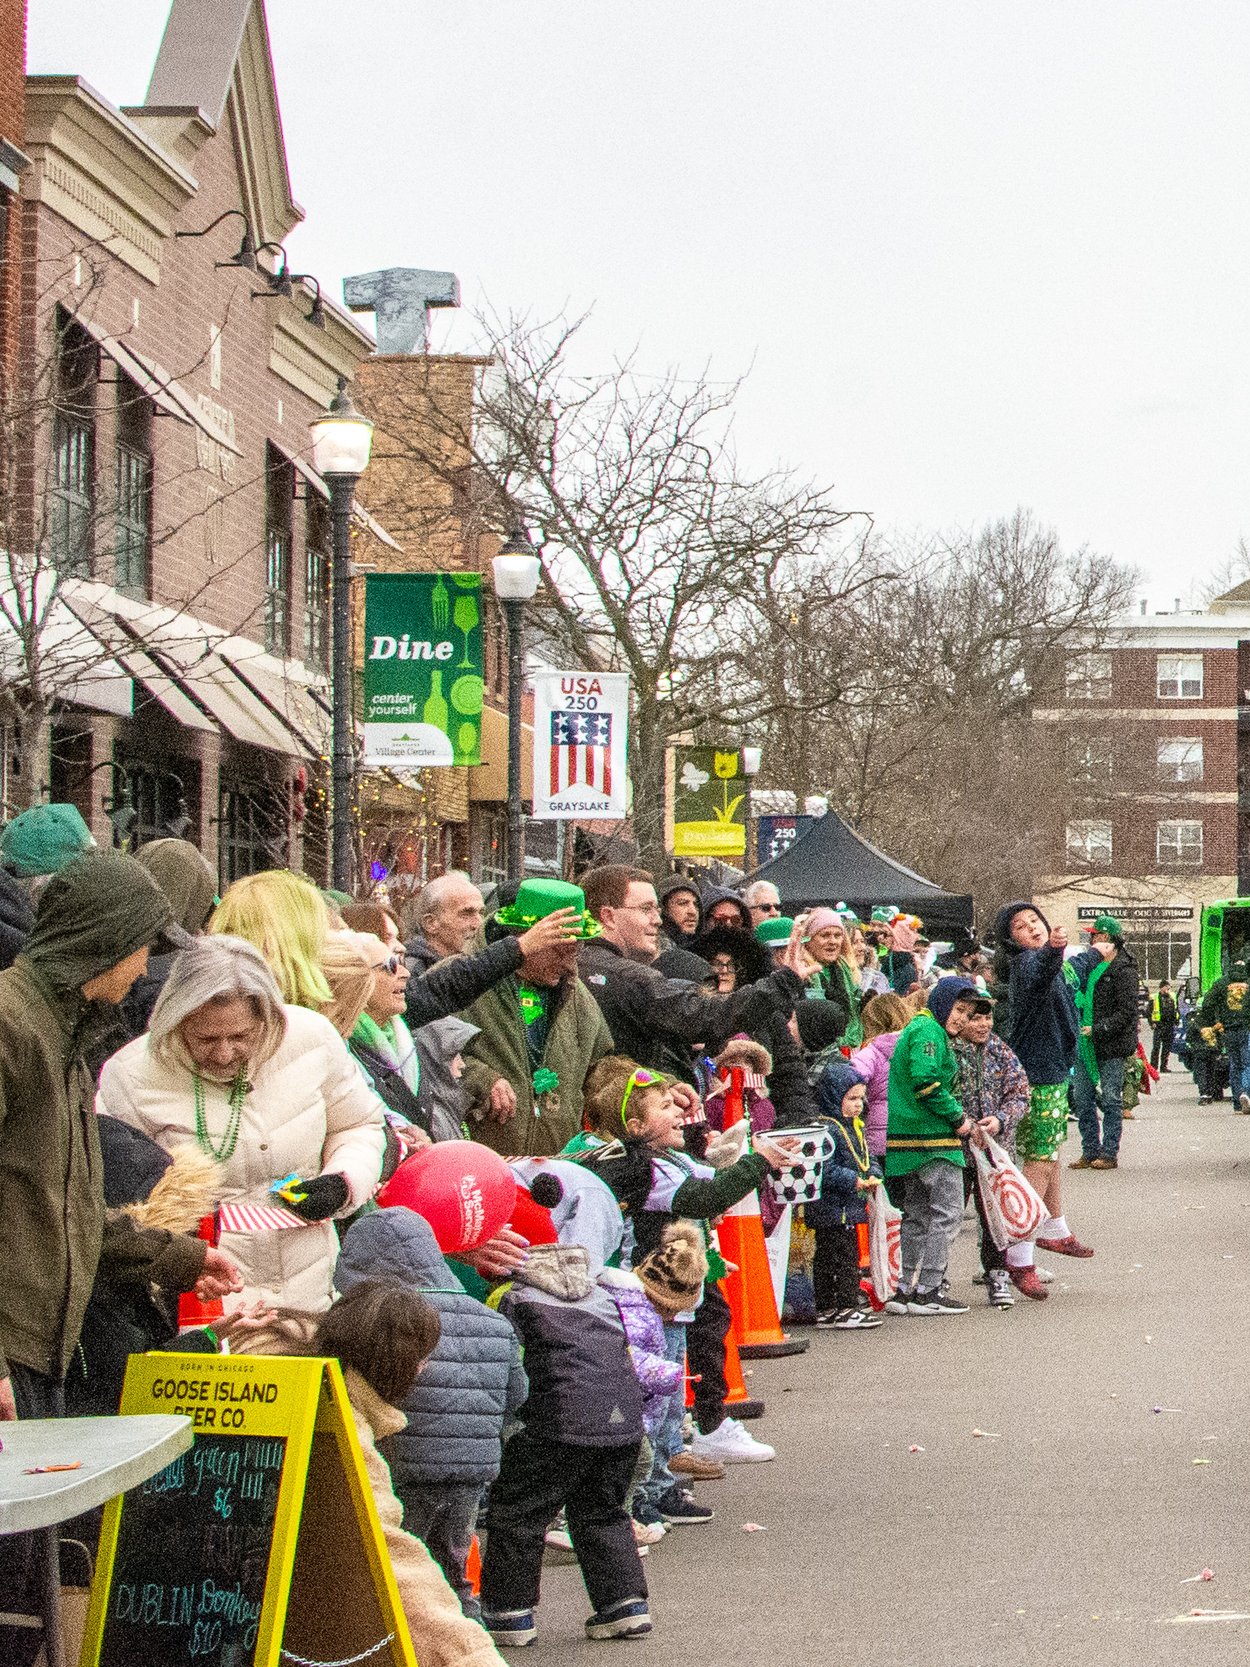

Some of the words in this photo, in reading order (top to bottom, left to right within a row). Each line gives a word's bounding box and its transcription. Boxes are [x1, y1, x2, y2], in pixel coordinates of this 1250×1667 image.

[369, 634, 454, 660] Dine
[561, 678, 603, 695] USA
[372, 692, 414, 704] center
[565, 696, 598, 711] 250
[368, 702, 417, 718] yourself
[375, 748, 405, 758] Village
[549, 801, 609, 811] GRAYSLAKE
[774, 828, 797, 838] 250
[1081, 909, 1105, 917] EXTRA
[180, 1363, 201, 1371] BORN
[218, 1364, 254, 1373] CHICAGO
[152, 1378, 211, 1401] GOOSE
[214, 1381, 278, 1404] ISLAND
[221, 1407, 247, 1429] CO.
[213, 1487, 232, 1519] $6
[116, 1583, 195, 1626] DUBLIN
[188, 1619, 222, 1658] $10
